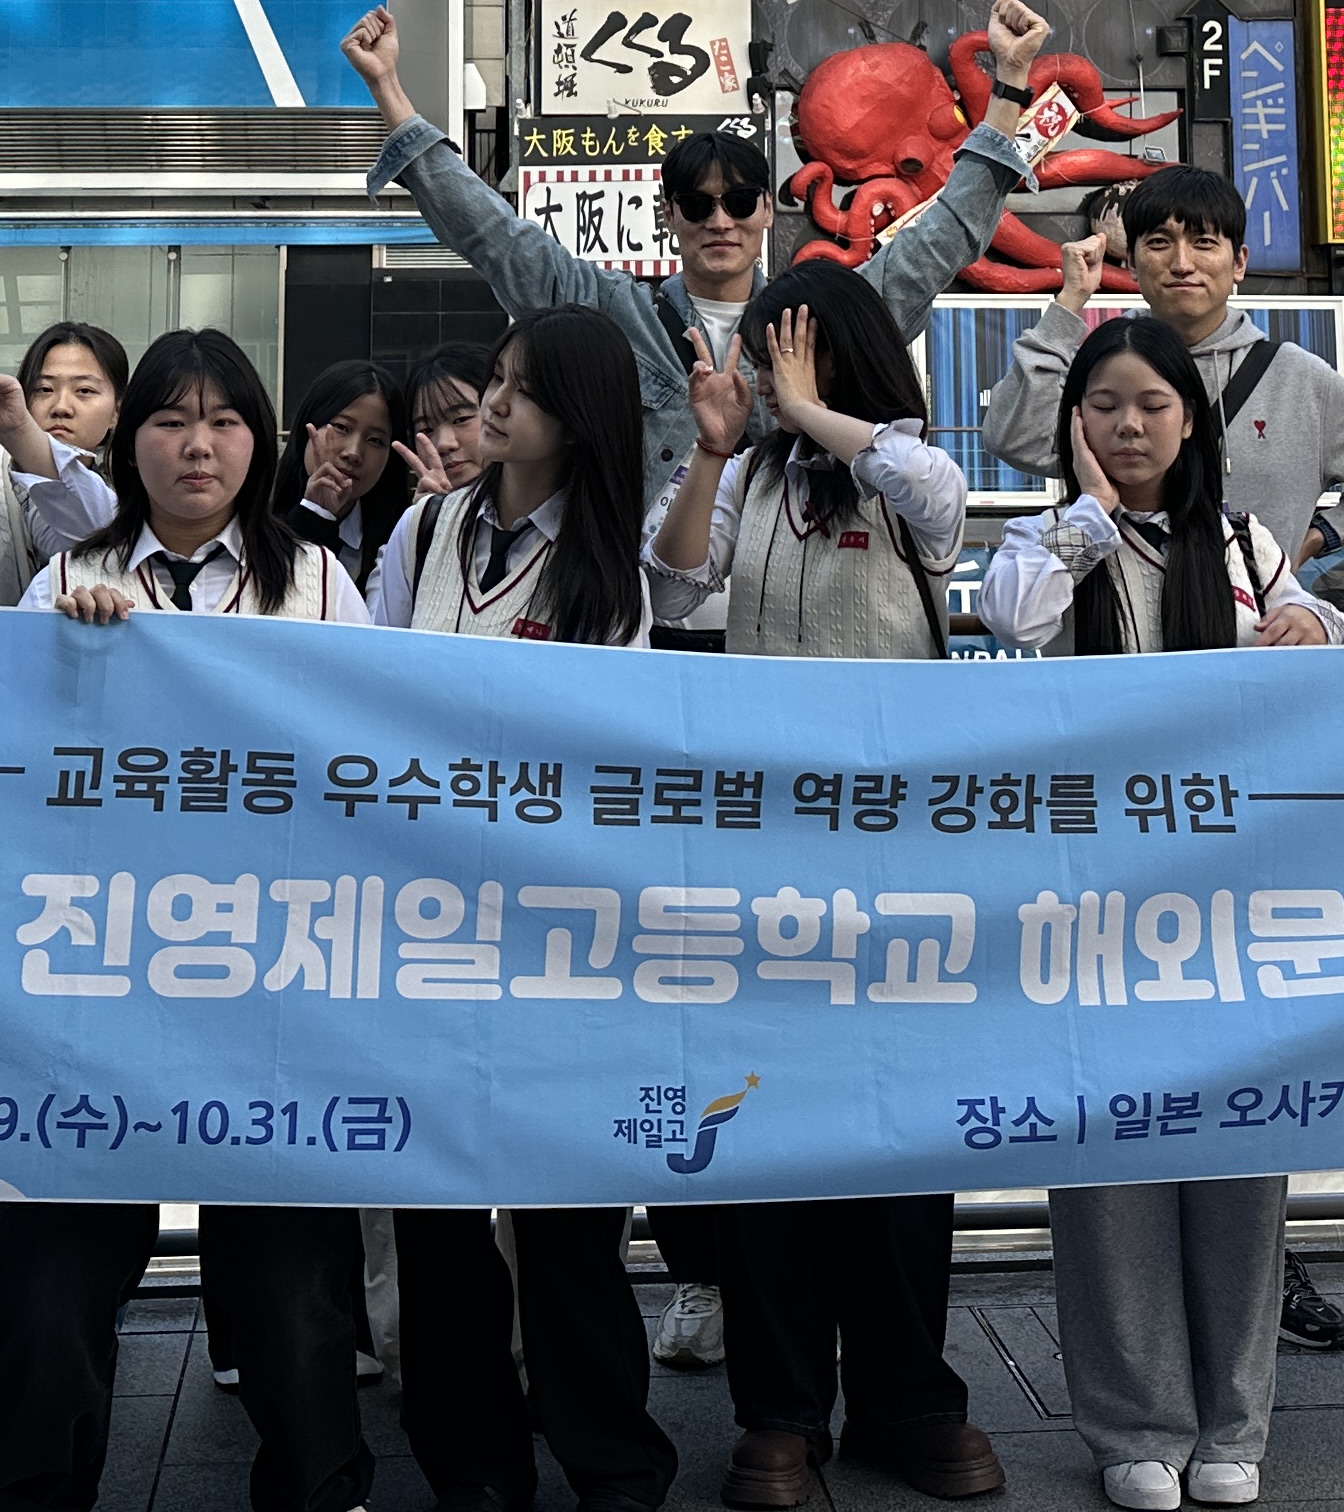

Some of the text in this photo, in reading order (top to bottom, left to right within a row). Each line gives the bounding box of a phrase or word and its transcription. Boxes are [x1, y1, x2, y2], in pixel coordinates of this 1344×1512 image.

[552, 8, 579, 99] 道頓堀
[580, 11, 711, 97] くくる
[625, 98, 668, 108] KUKURU
[47, 746, 1238, 835] 교육활동 우수학생 글로벌 역량 강화를 위한
[13, 870, 978, 1005] 진영제일고등학교
[613, 1118, 688, 1148] 제일고
[638, 1085, 687, 1115] 진영
[954, 1095, 1058, 1151] 장소
[1111, 1092, 1203, 1140] 일본
